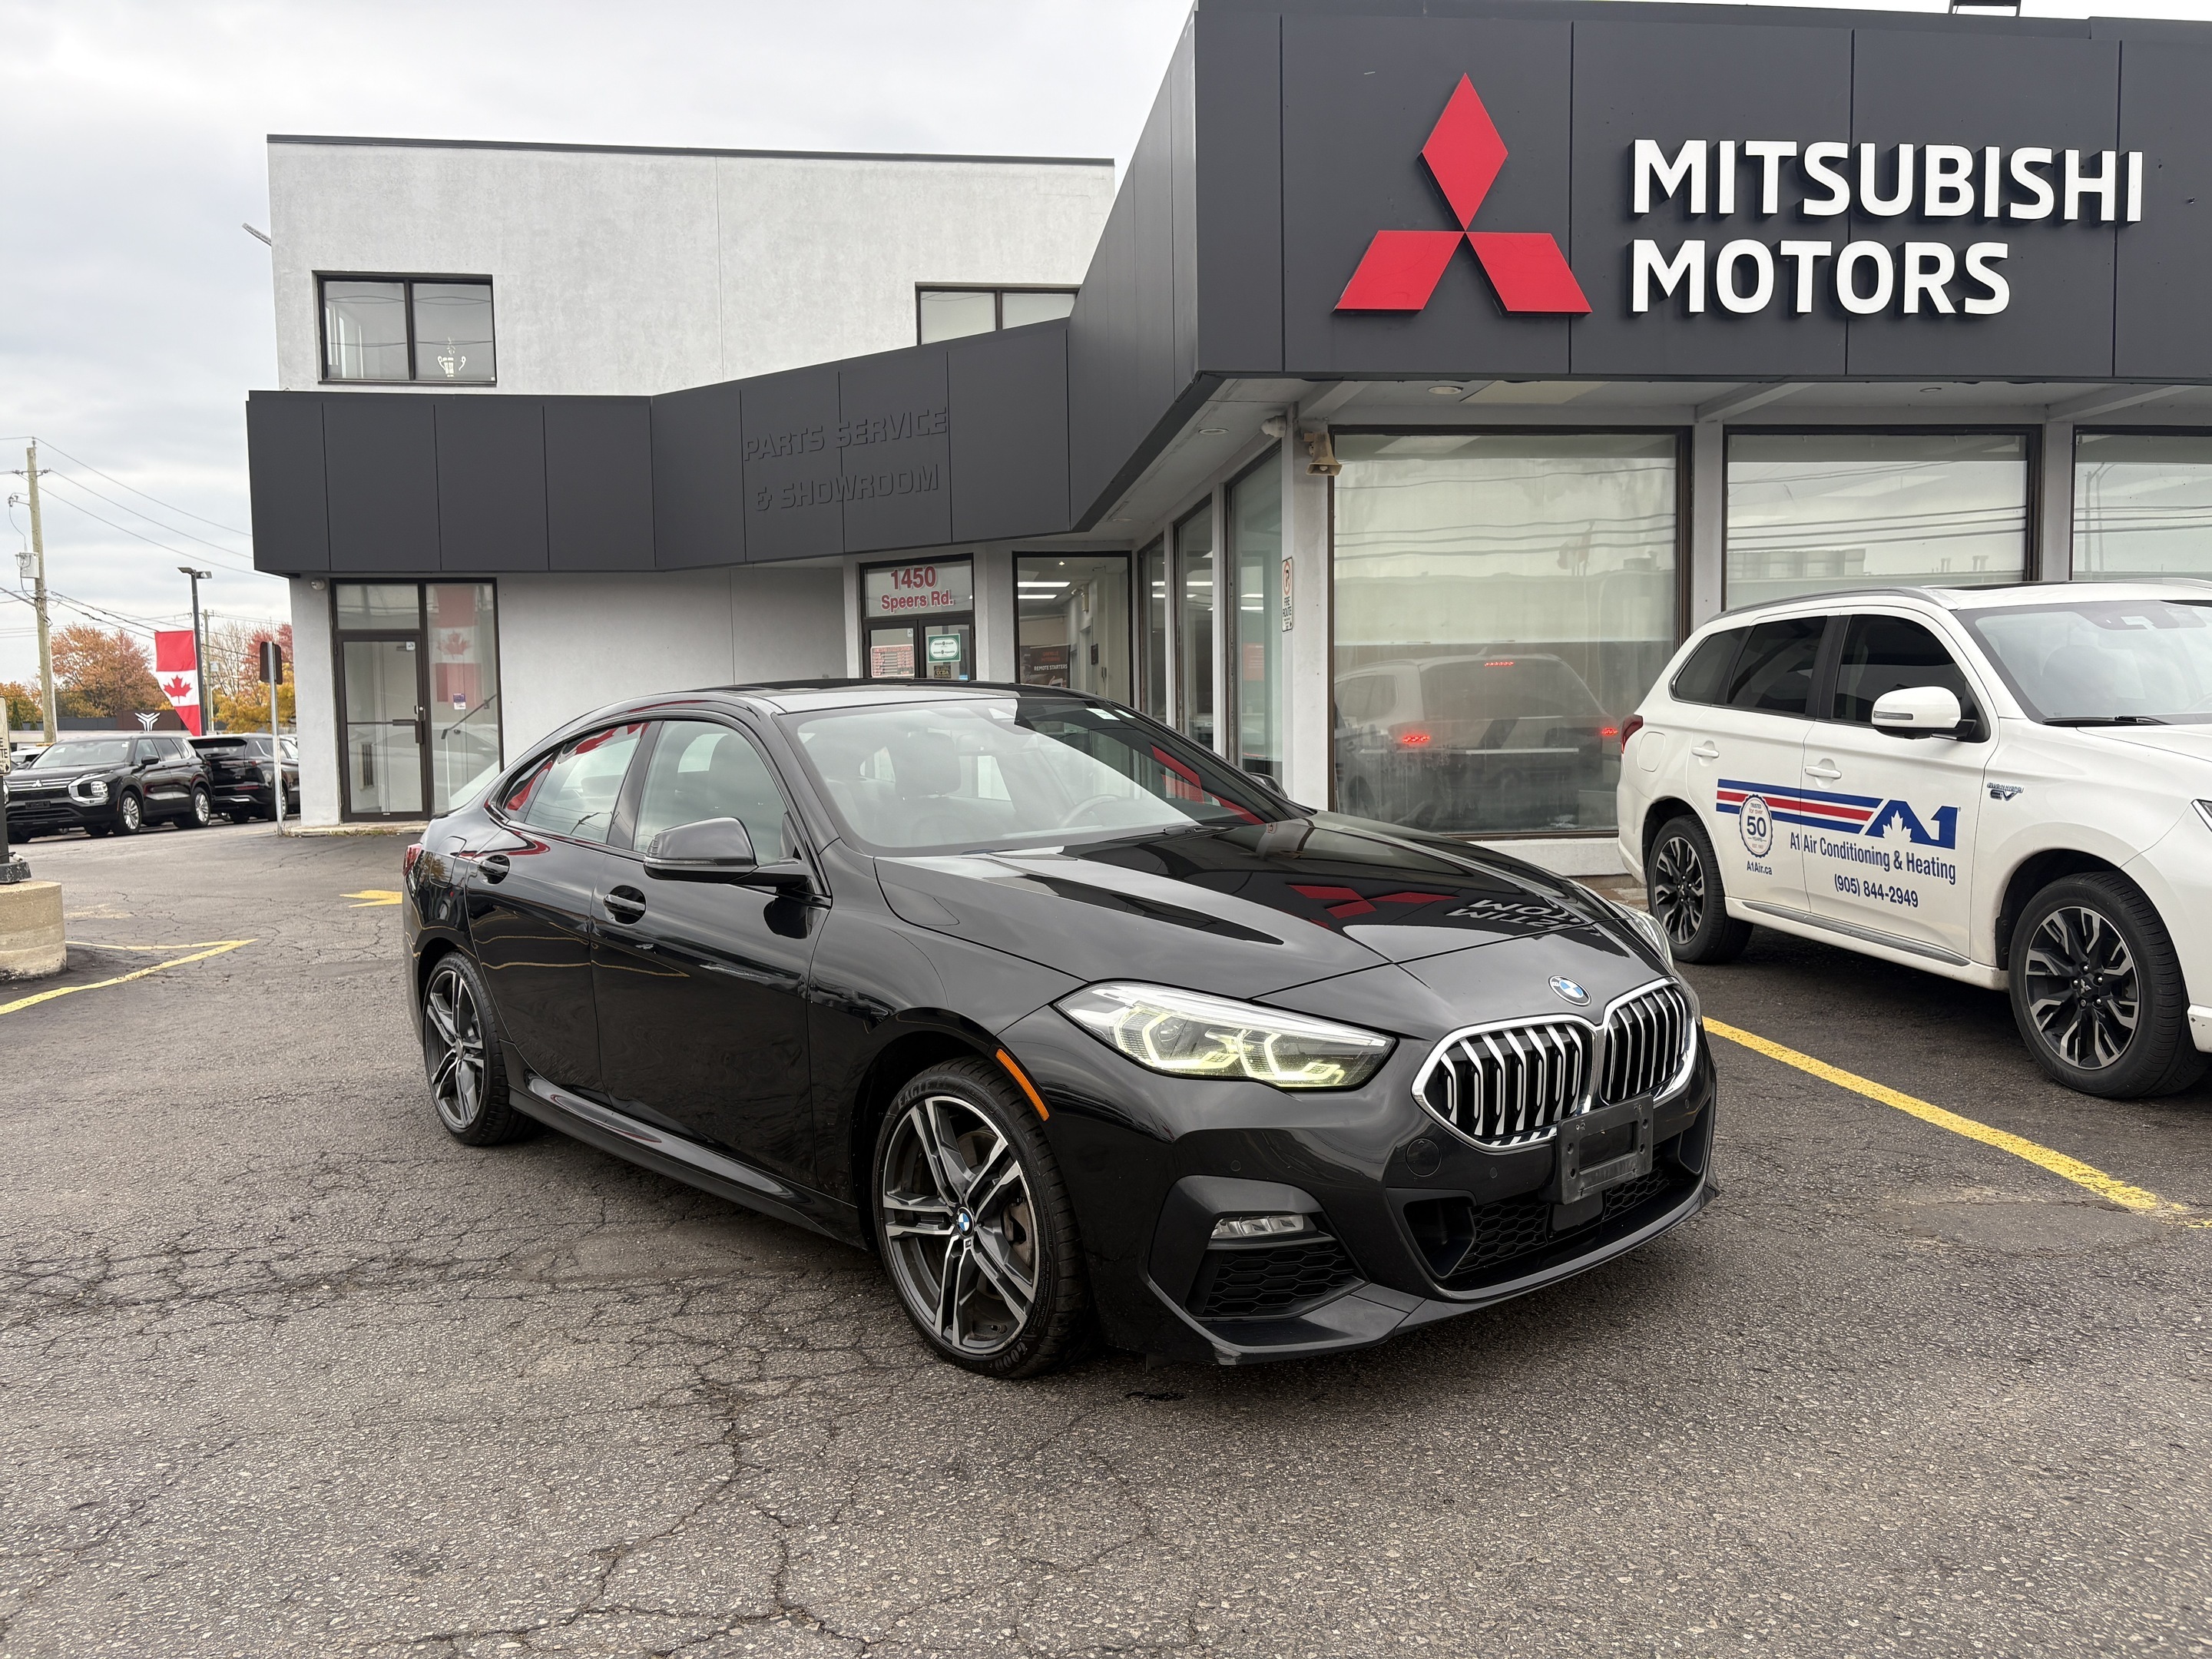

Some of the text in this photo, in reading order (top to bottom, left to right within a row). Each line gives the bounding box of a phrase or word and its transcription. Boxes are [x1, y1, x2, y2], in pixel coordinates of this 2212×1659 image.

[1631, 139, 2143, 222] MITSUBISHI
[1630, 239, 2010, 315] MOTORS
[743, 406, 947, 462] PARTS SERVICE
[755, 464, 939, 512] & SHOWROOM
[891, 566, 936, 590] 1450
[881, 590, 954, 613] Speers Rd.
[1747, 815, 1767, 837] 50
[1747, 860, 1773, 875] A1Air.ca
[1790, 832, 1956, 886] A1 Air Conditioning & Heating
[1834, 873, 1918, 908] (905) 844-2949
[896, 1079, 932, 1109] EAGLE
